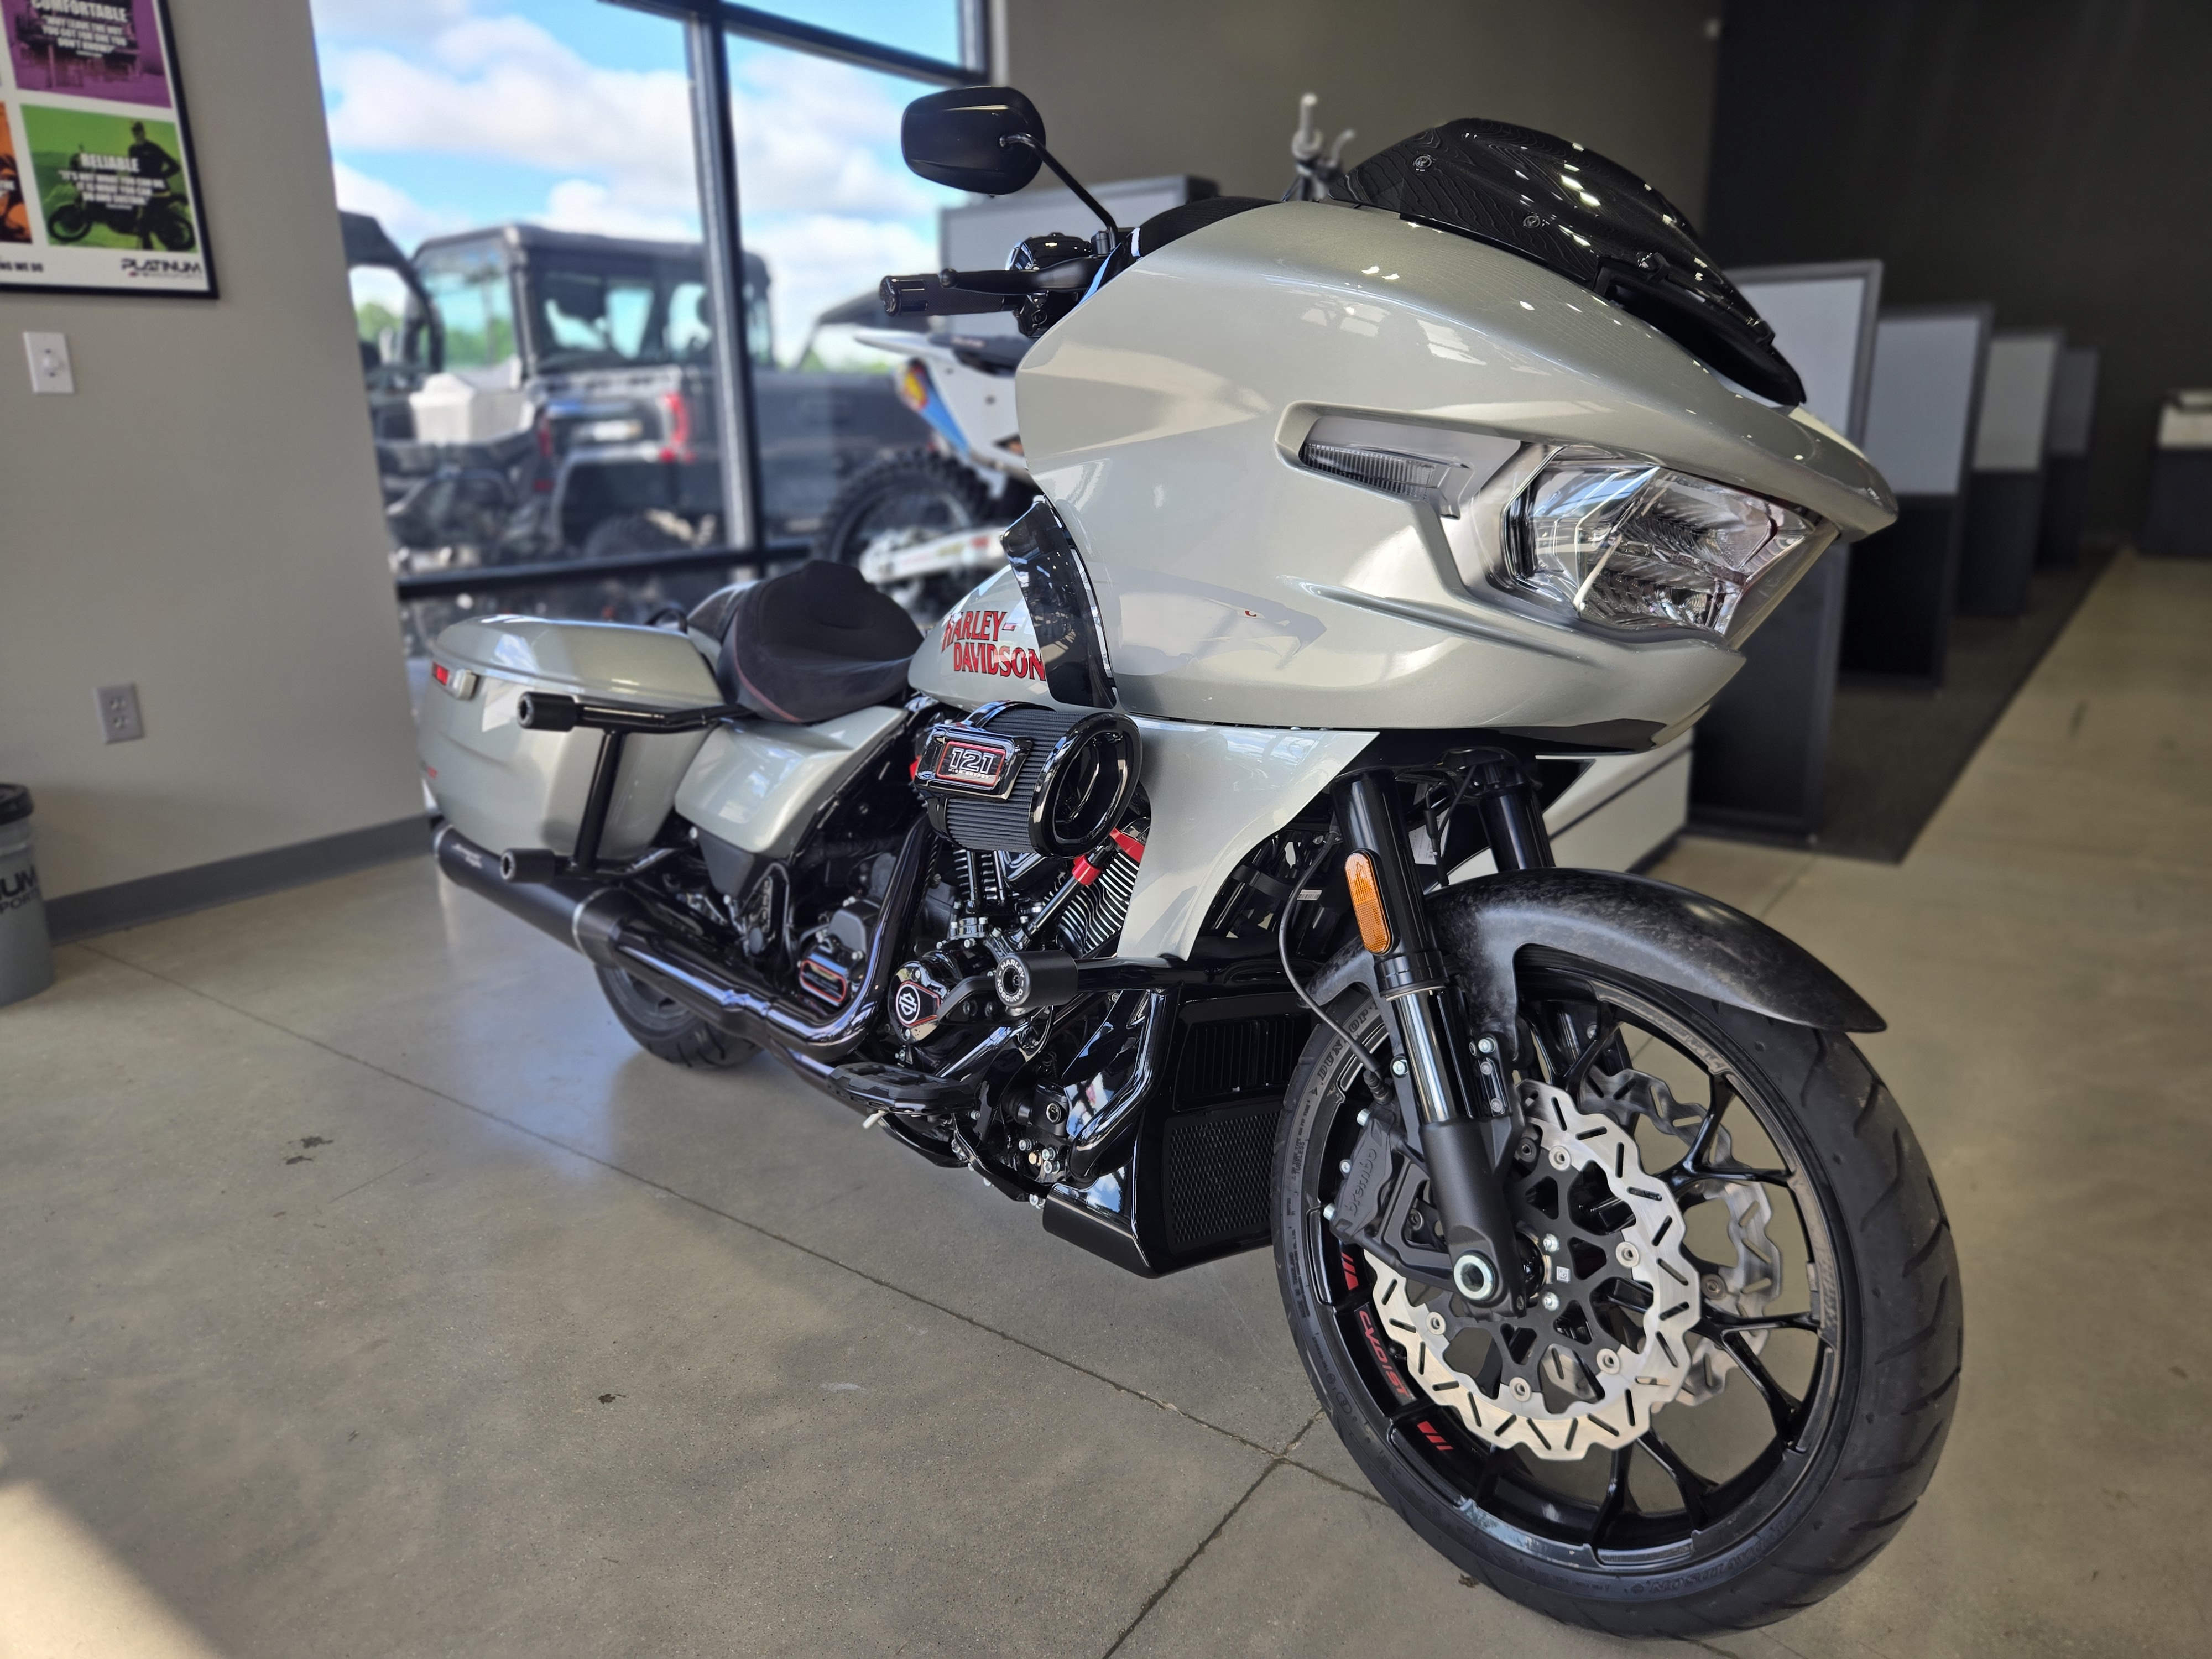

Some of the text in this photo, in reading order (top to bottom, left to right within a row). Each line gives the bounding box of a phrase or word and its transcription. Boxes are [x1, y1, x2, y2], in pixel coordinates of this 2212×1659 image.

[80, 153, 140, 173] RELIABLE
[954, 641, 1047, 682] DAVIDSON
[950, 747, 995, 774] 121
[1000, 959, 1025, 978] HARLEY
[1344, 1147, 1378, 1217] brembo
